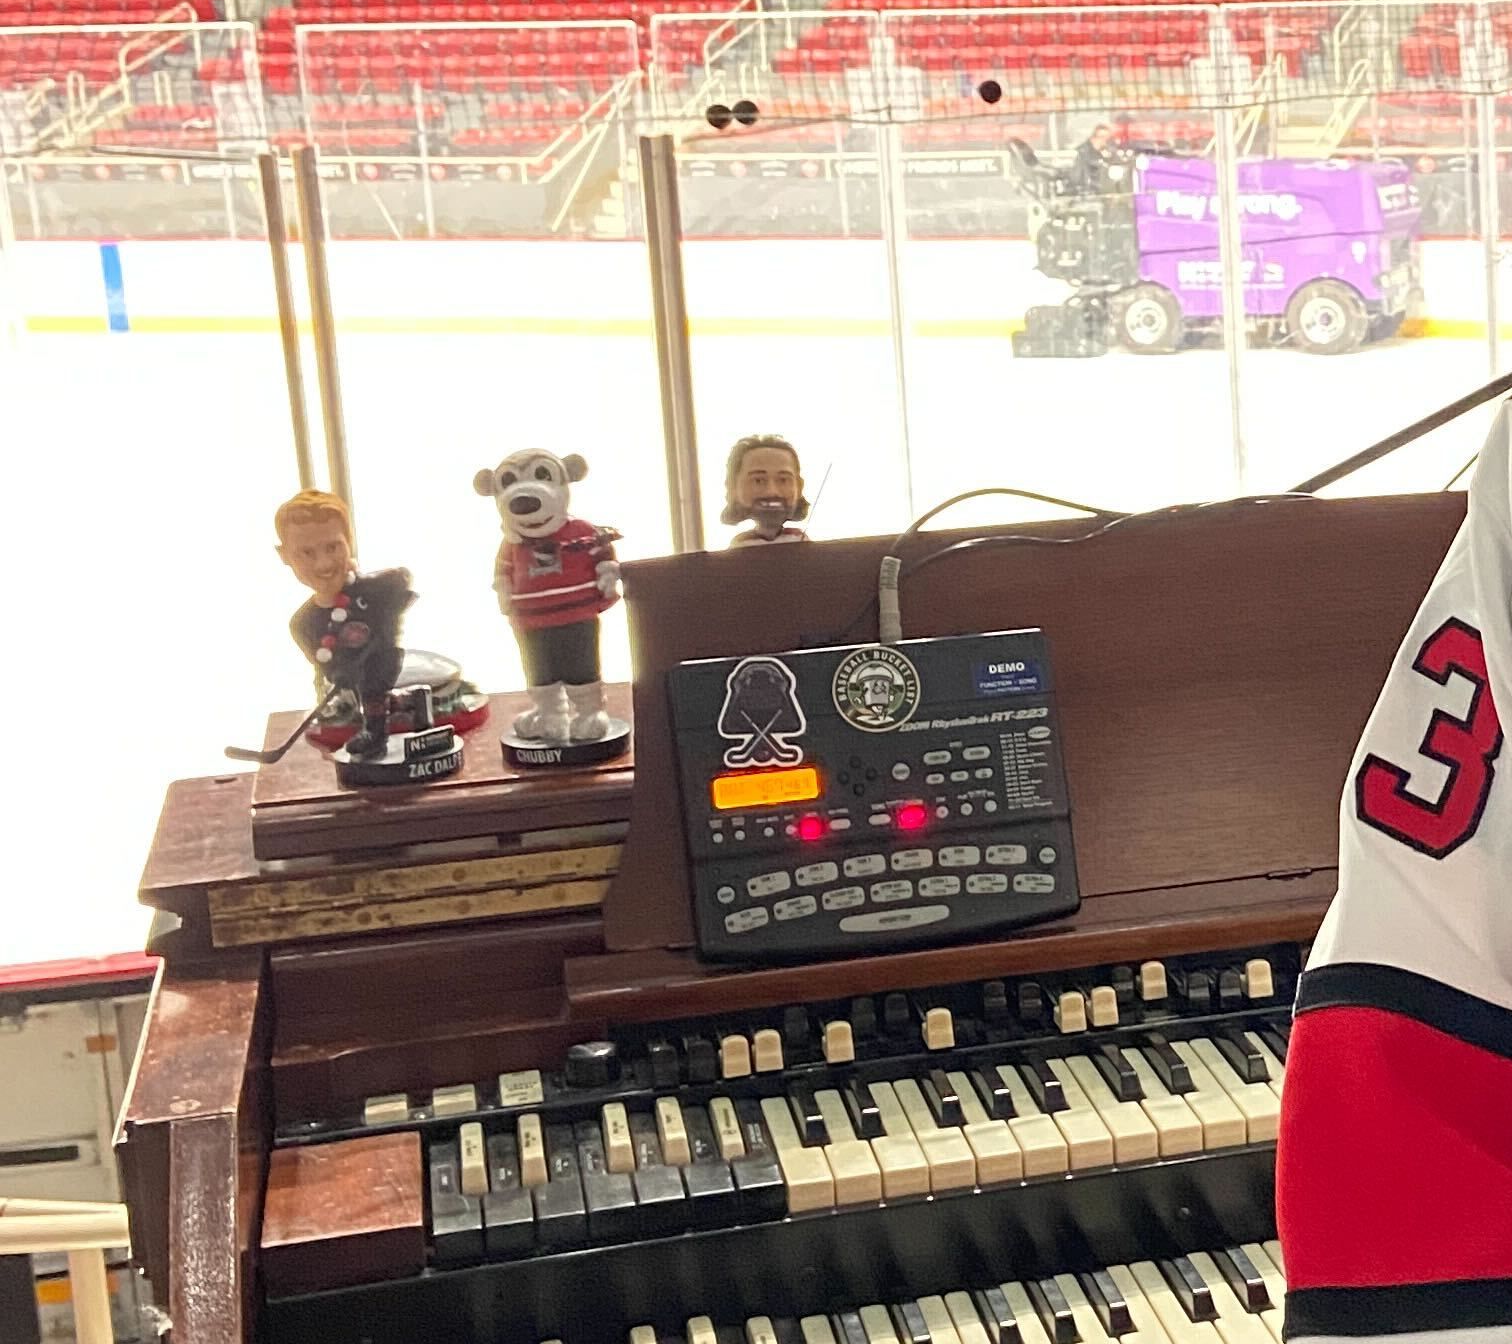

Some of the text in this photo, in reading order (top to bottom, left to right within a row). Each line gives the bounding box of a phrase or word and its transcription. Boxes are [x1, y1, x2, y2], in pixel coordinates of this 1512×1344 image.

[988, 662, 1025, 674] DEMO
[837, 652, 869, 702] BASEBALL
[873, 650, 911, 676] BUCKET
[1355, 616, 1504, 860] 3
[516, 749, 562, 764] CHUBBY
[409, 763, 432, 778] ZAC
